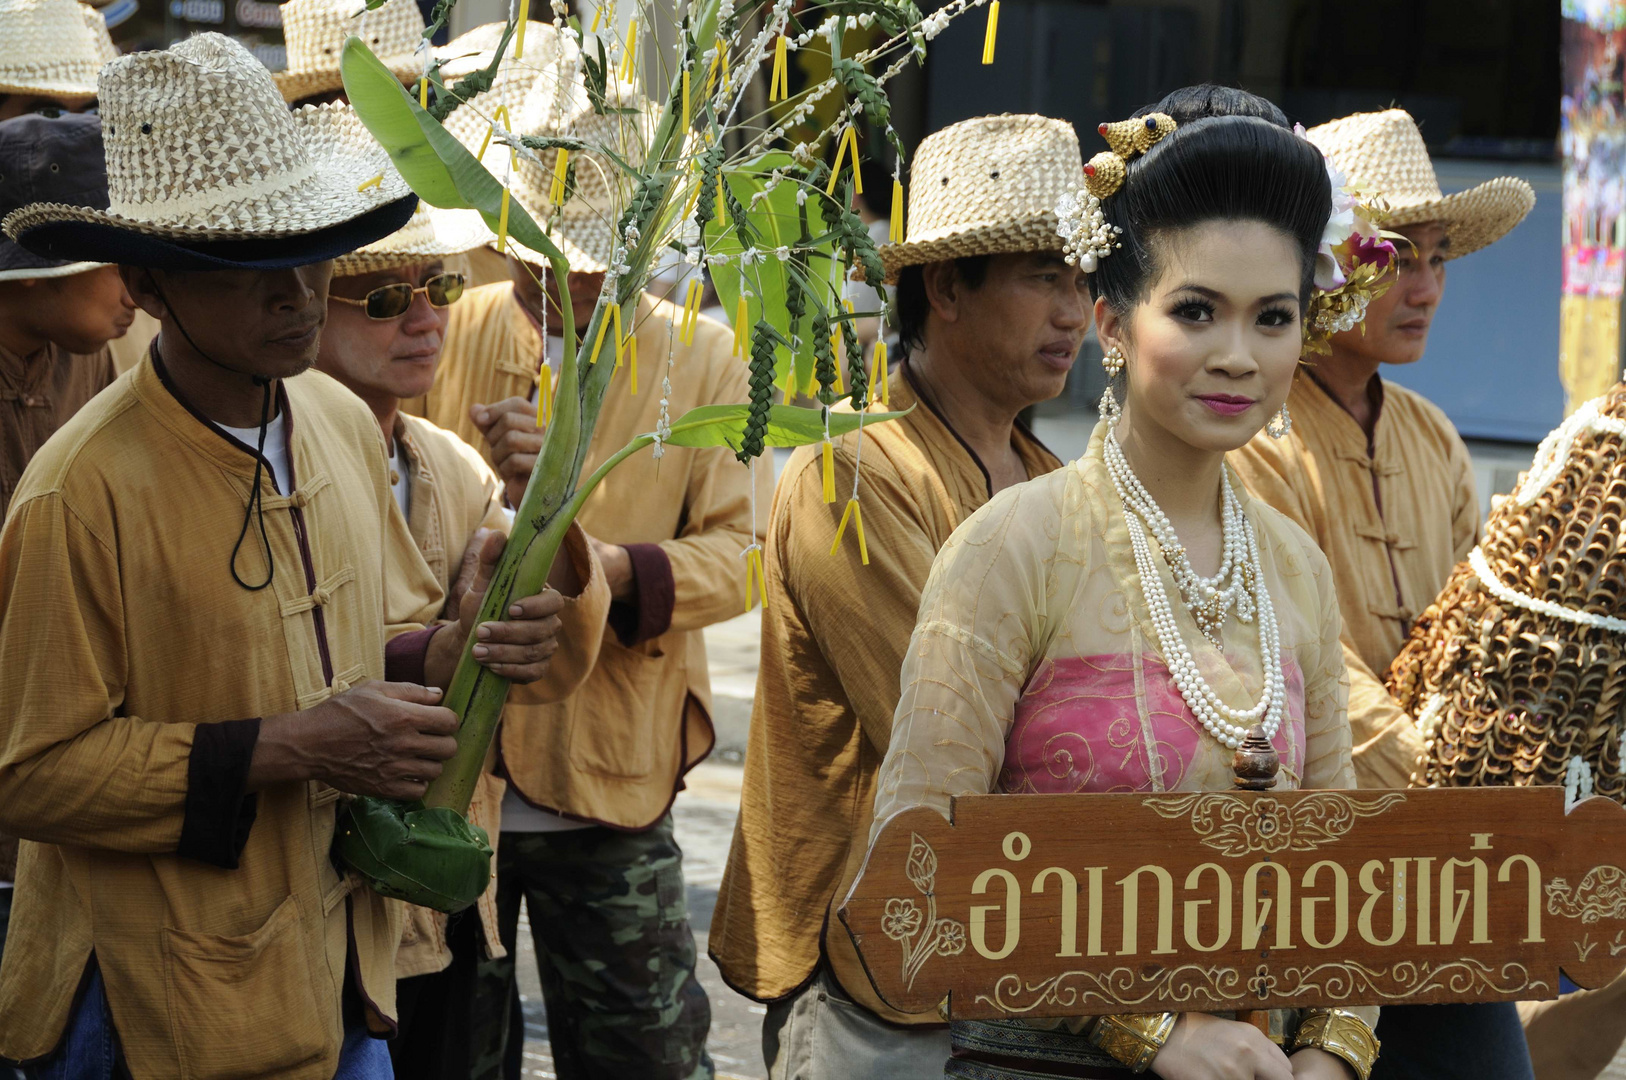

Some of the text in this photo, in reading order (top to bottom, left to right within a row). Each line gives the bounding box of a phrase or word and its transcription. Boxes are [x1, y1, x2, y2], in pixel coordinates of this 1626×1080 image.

[969, 831, 1546, 960] อำเภอดอยเต่า
